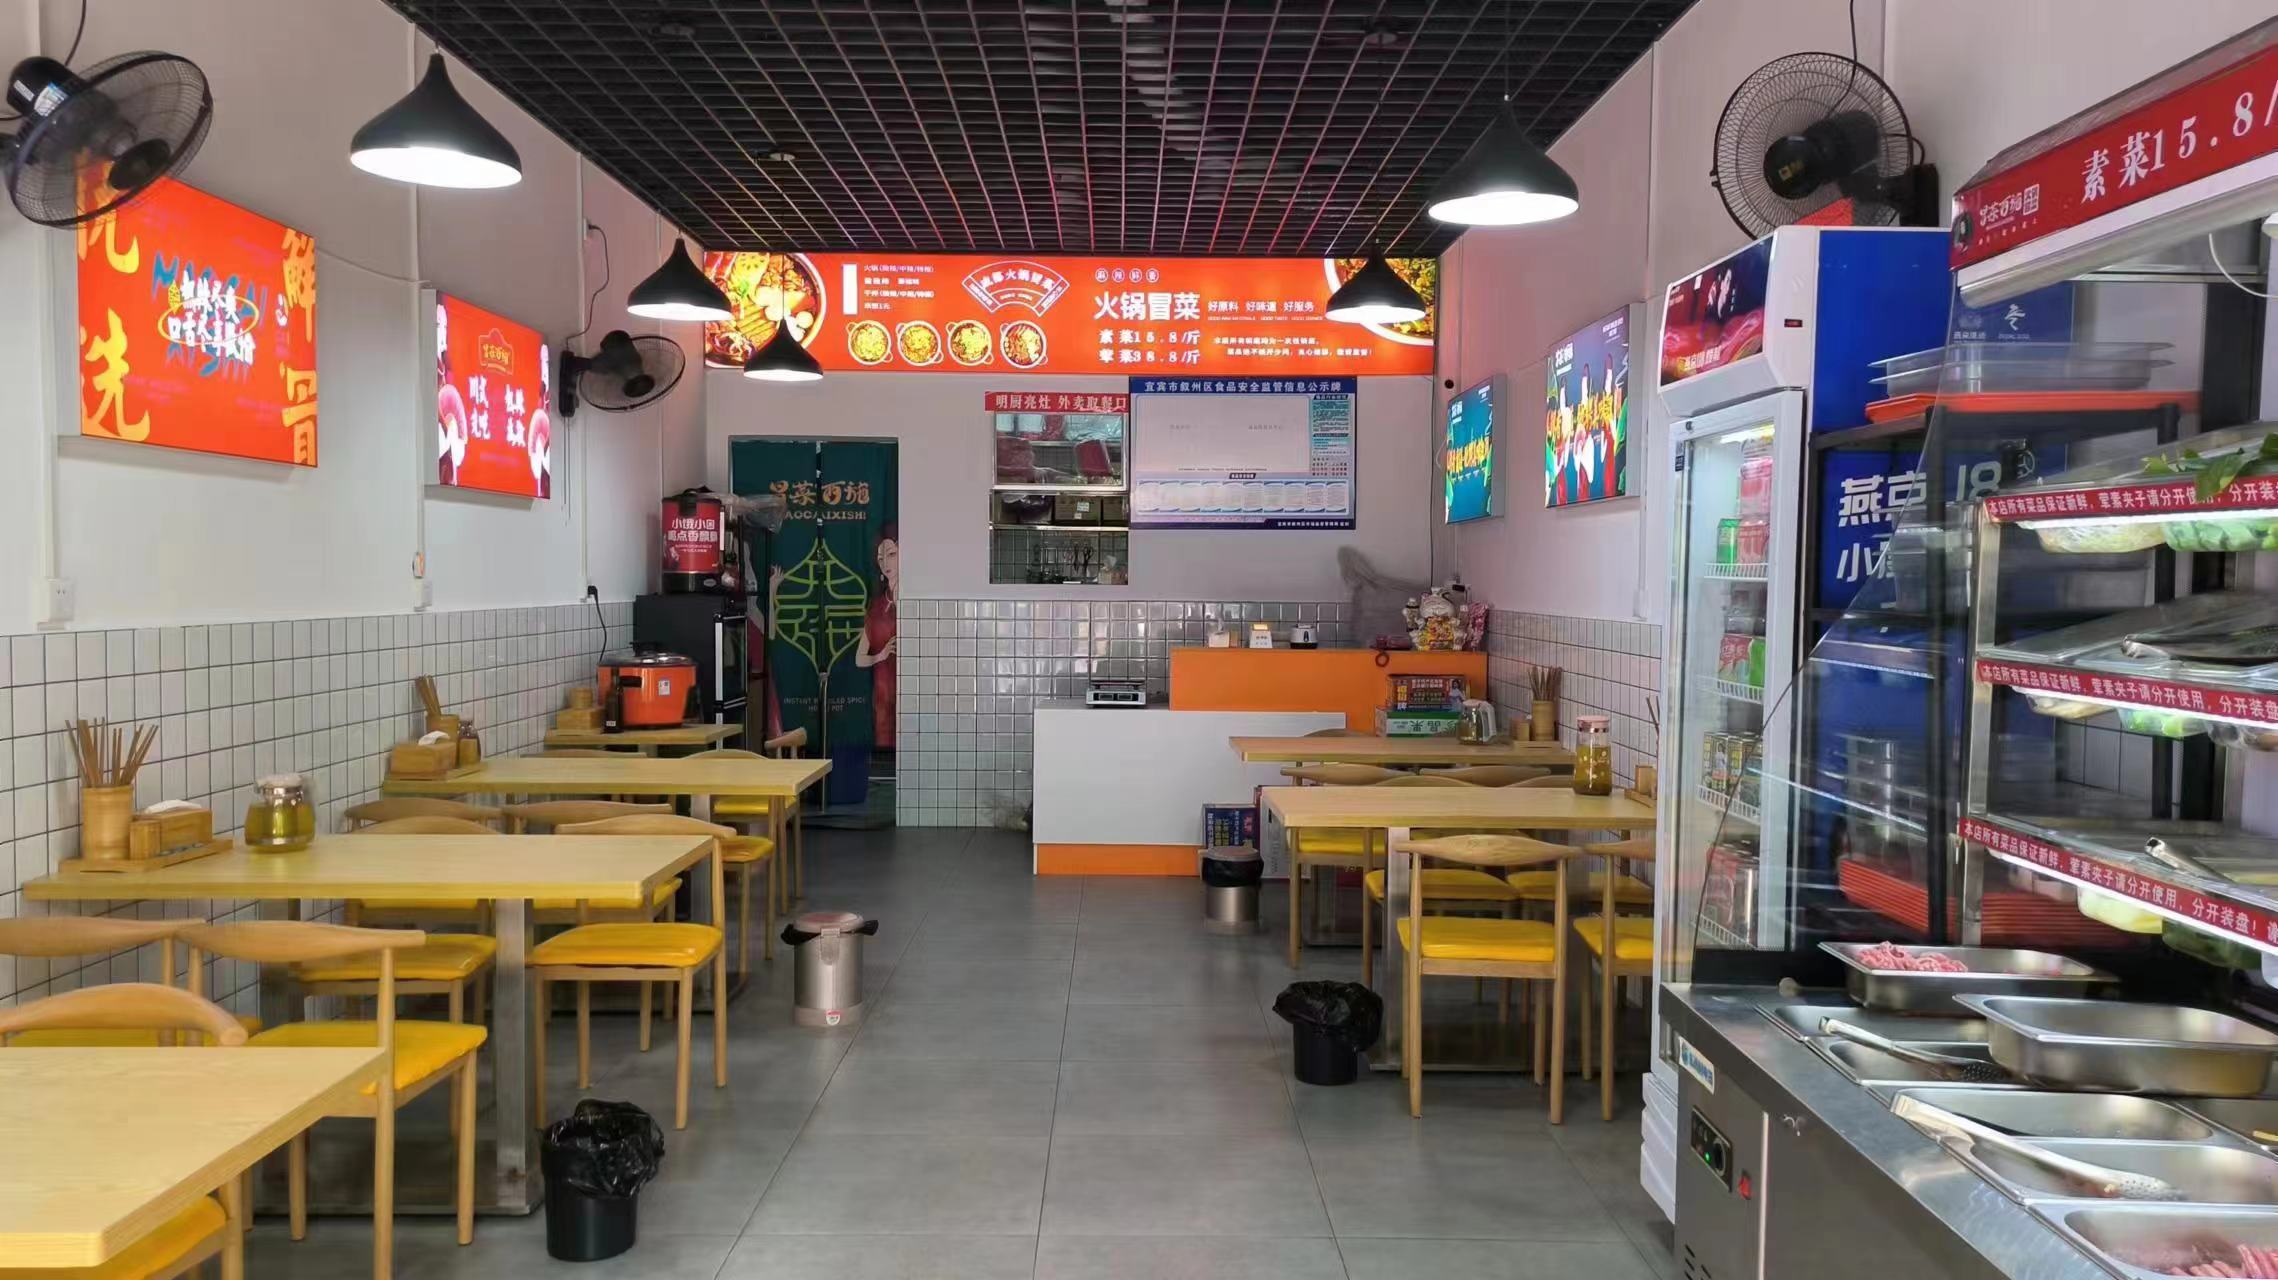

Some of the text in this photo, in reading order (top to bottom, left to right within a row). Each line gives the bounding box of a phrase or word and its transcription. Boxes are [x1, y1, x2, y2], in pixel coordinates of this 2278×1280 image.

[1093, 291, 1201, 321] 火锅冒菜
[1207, 301, 1315, 313] 好原料 好味道 好服务
[1144, 381, 1341, 393] 宜宾市叙州区食品安全监管信息公示牌
[996, 394, 1126, 409] 明厨亮灶 外卖取餐口
